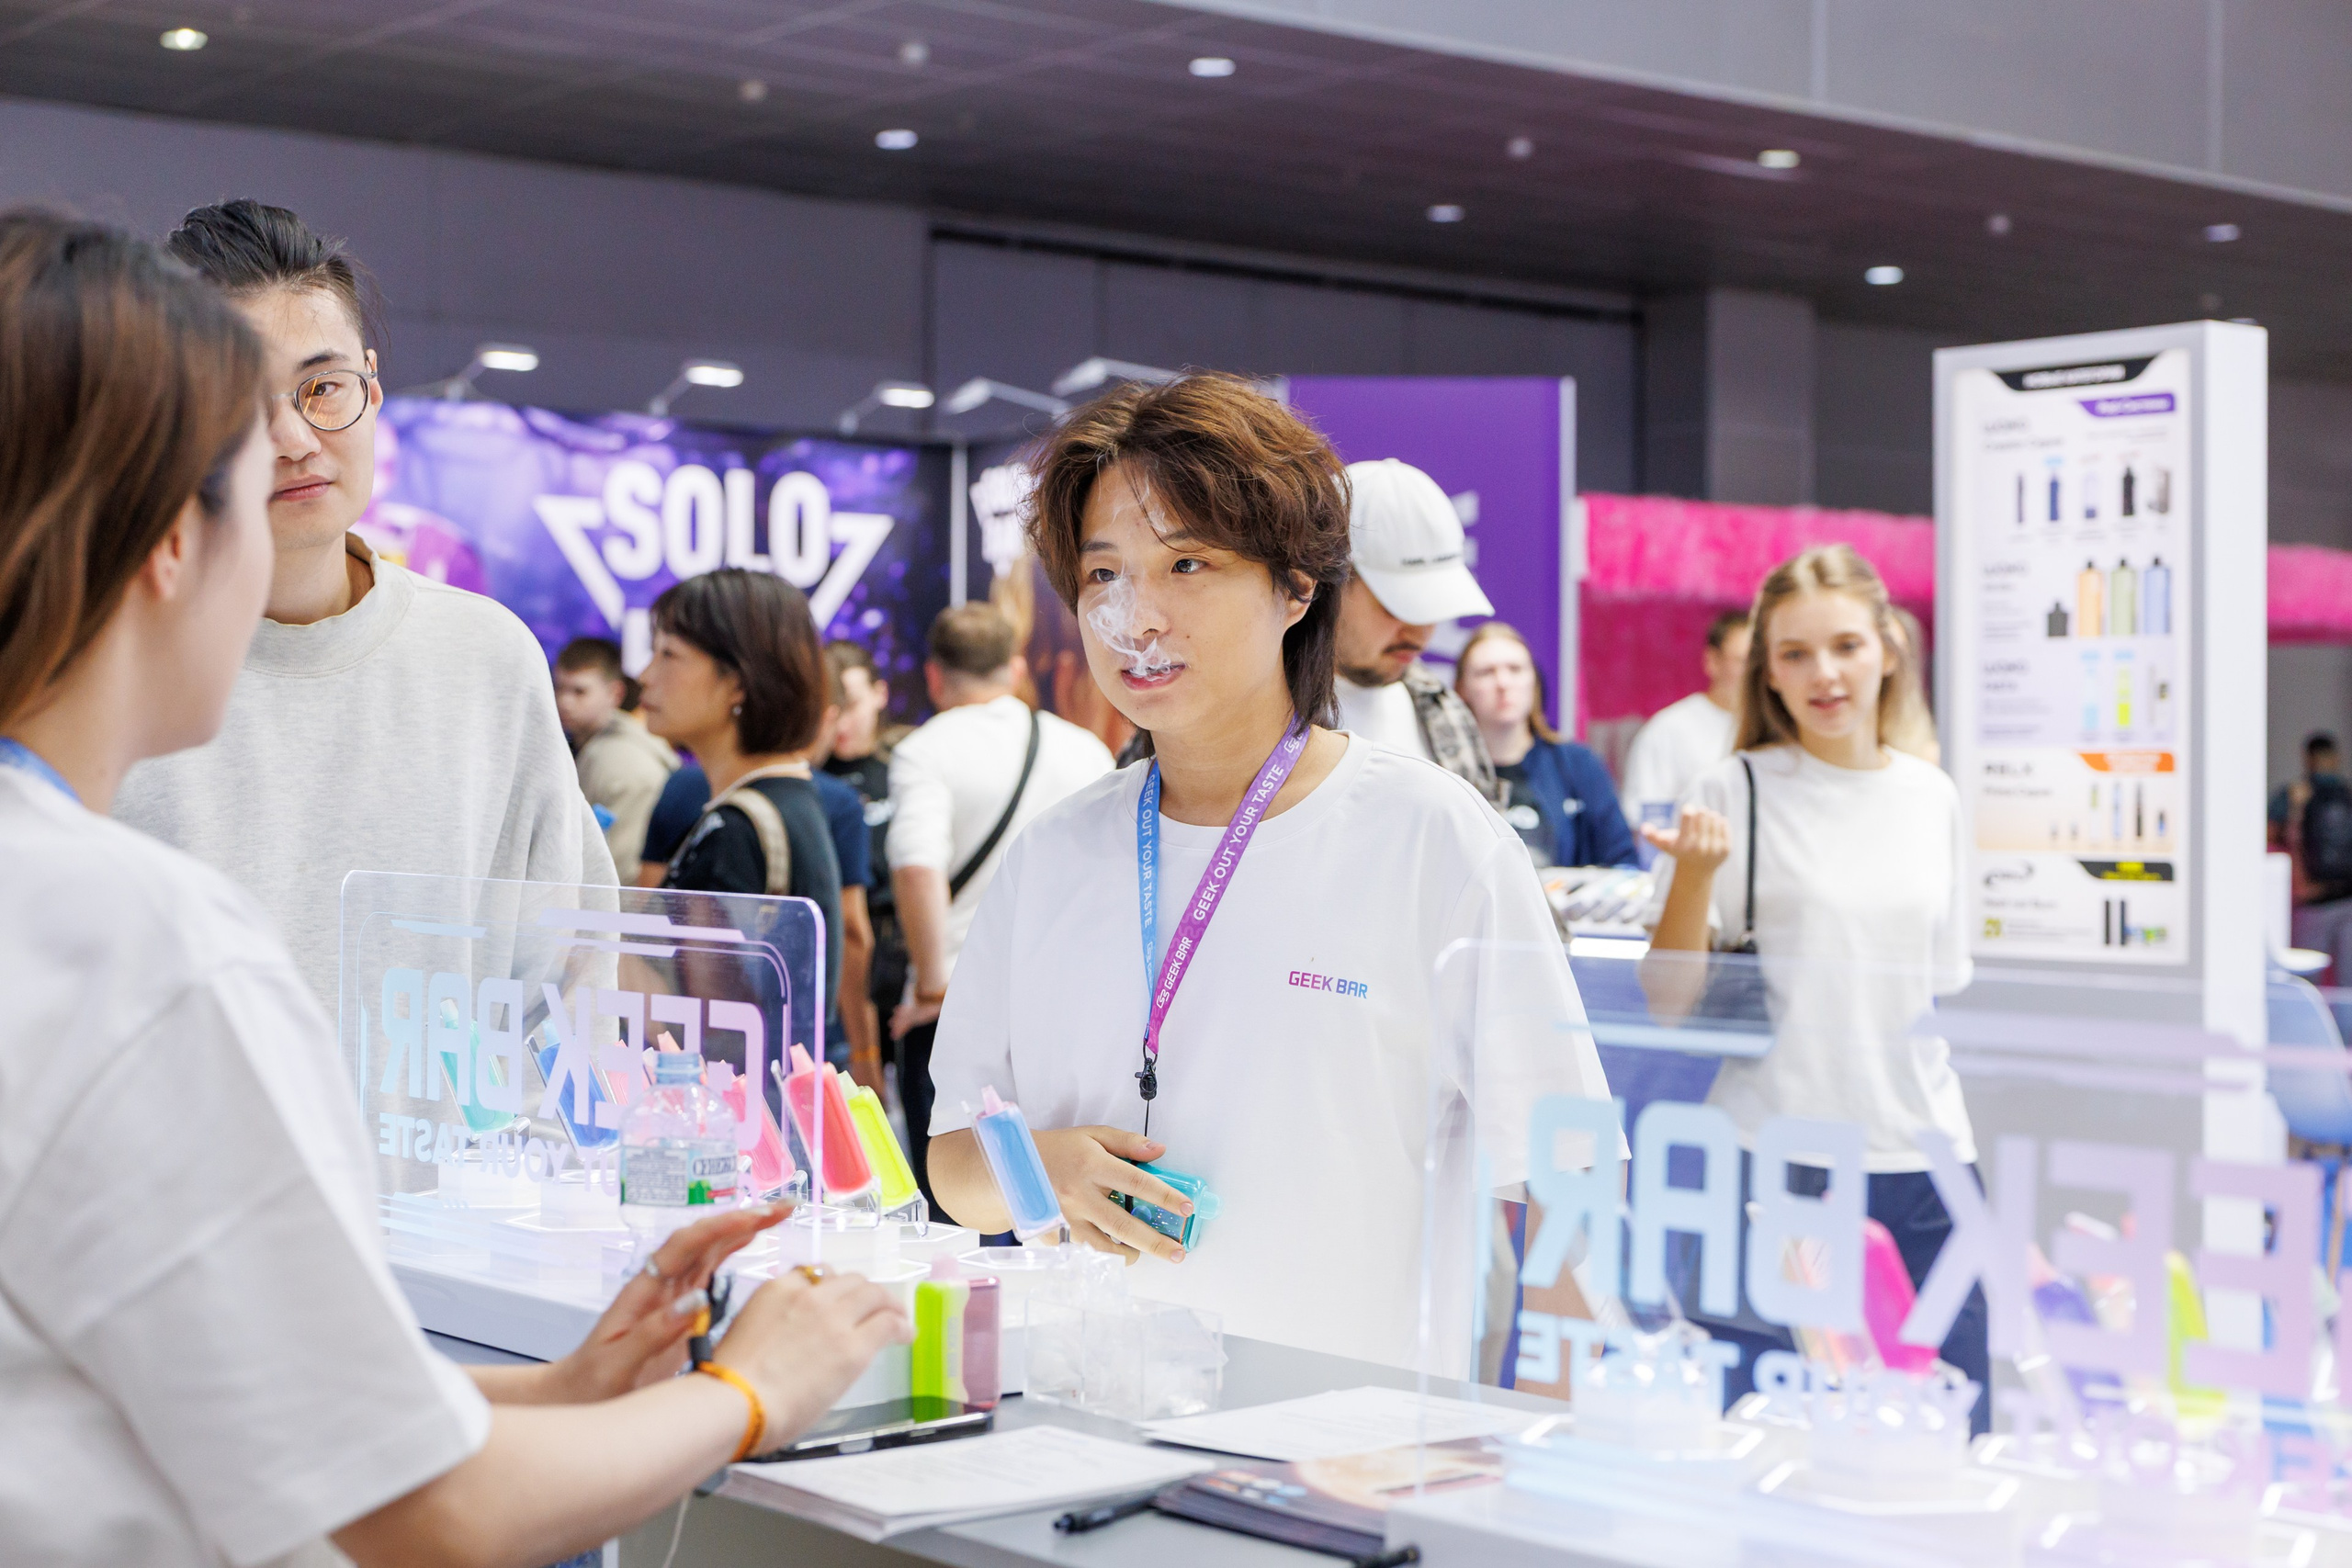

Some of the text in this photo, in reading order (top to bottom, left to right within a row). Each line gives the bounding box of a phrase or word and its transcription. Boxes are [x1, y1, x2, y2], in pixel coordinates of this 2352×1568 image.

[603, 460, 831, 588] SOLO
[1142, 809, 1152, 837] OUT
[1193, 763, 1284, 921] GEEK OUT YOUR TASTE
[1142, 840, 1152, 881] YOUR
[1143, 884, 1153, 929] TASTE
[1164, 936, 1193, 989] GEEK BAR
[1288, 970, 1368, 999] GEEK BAR
